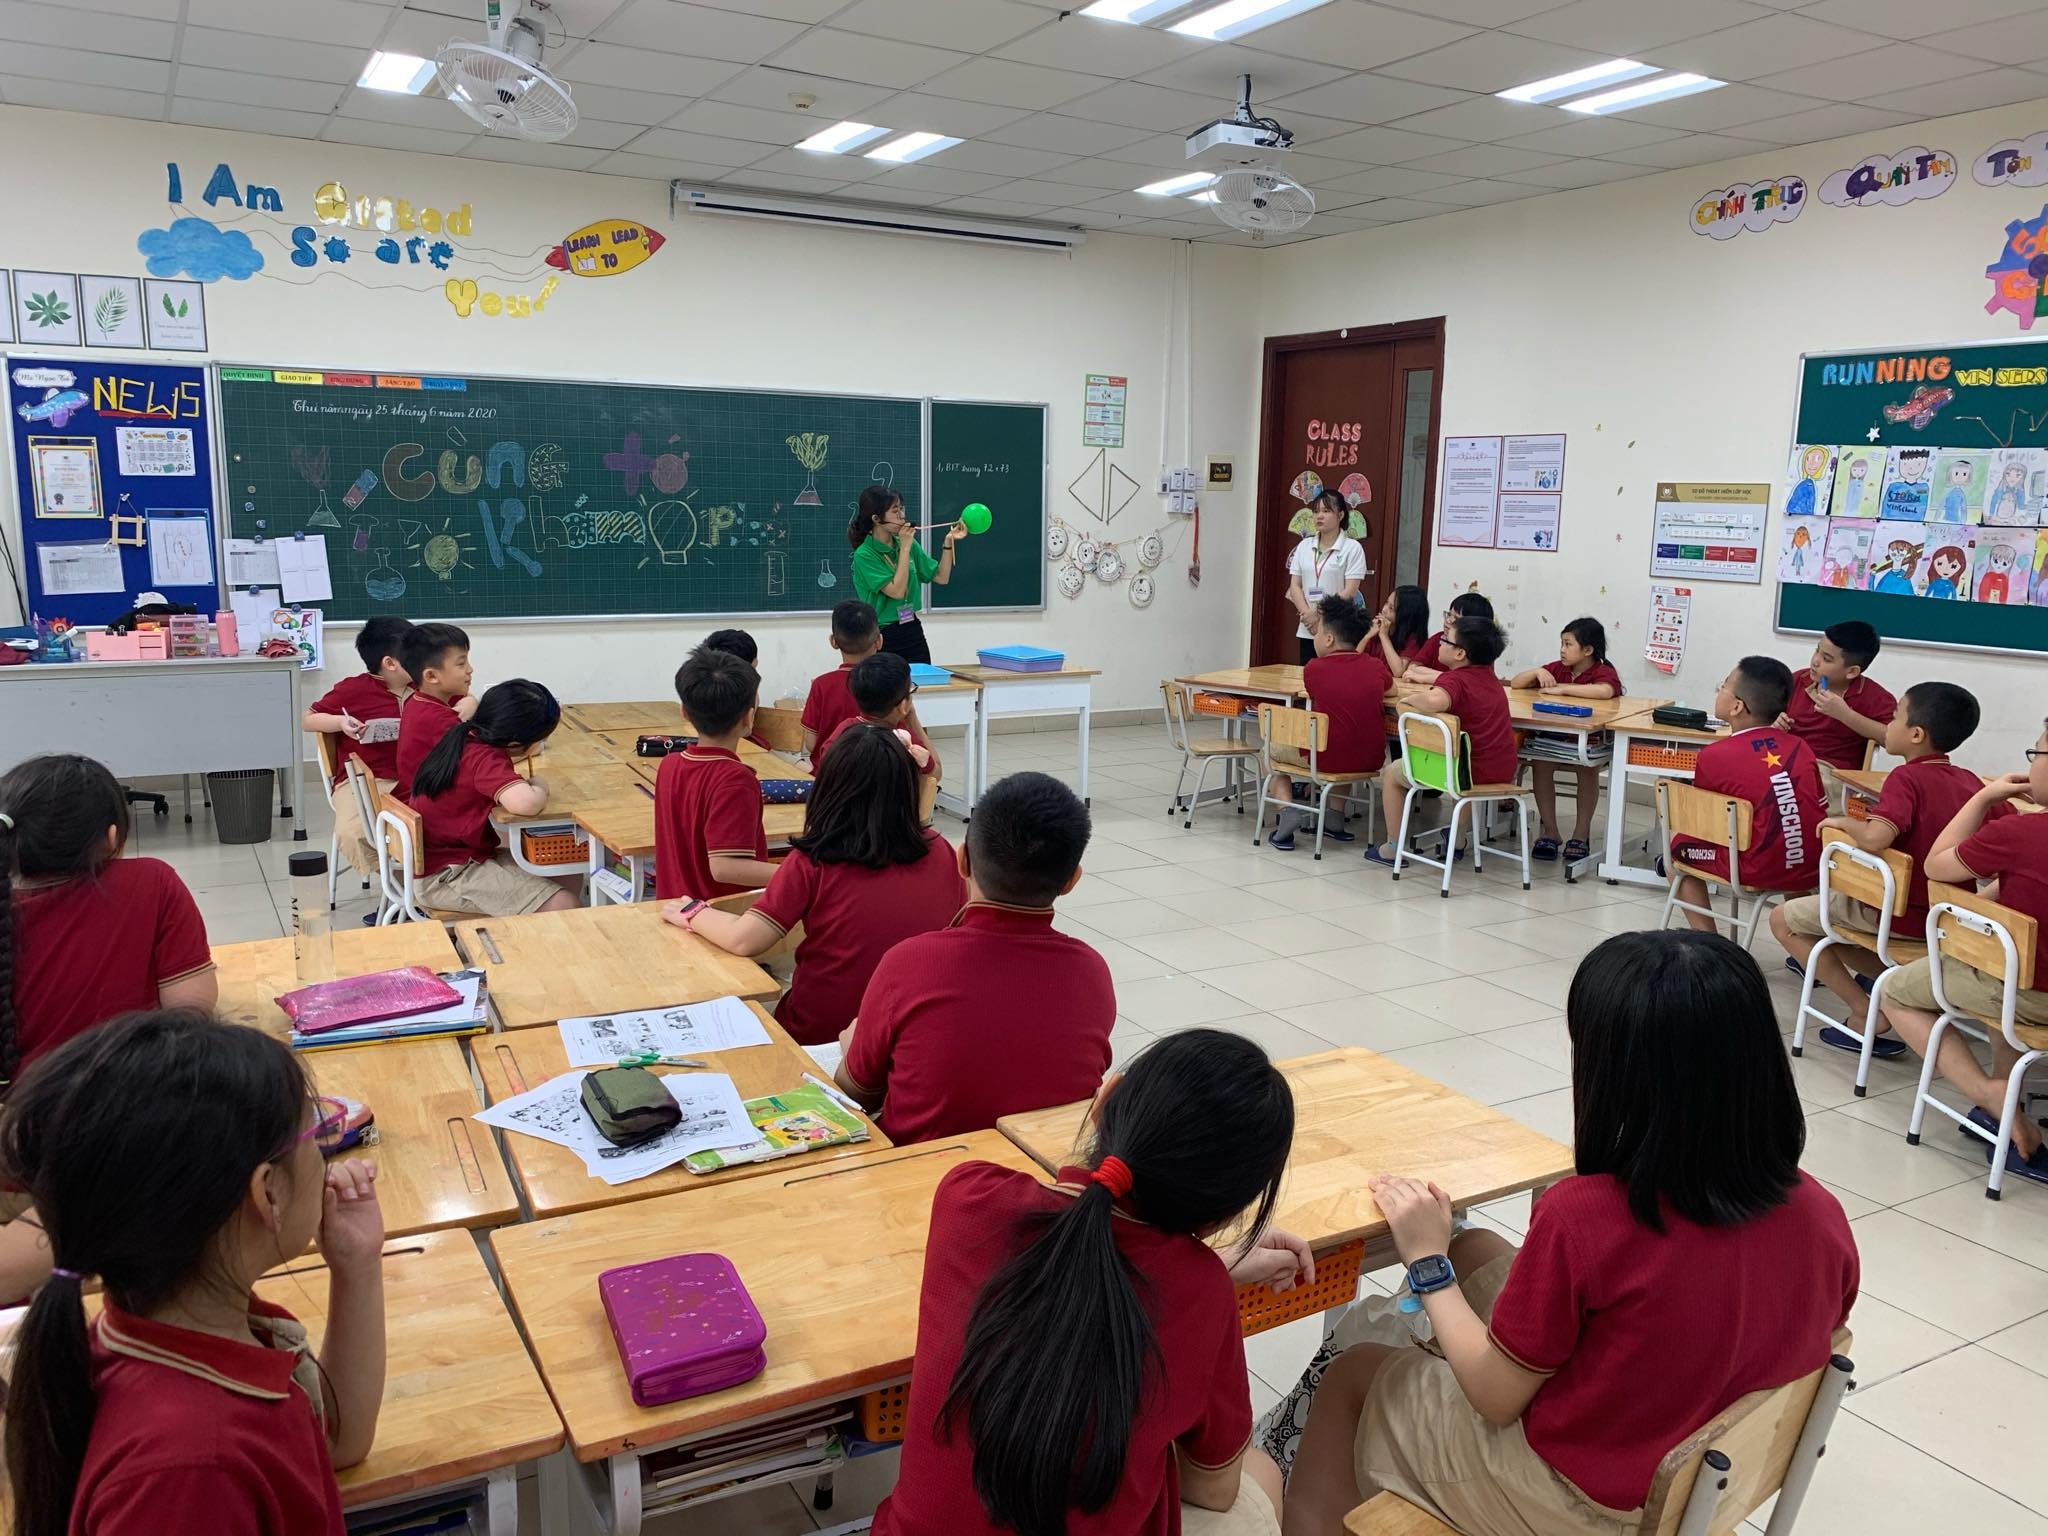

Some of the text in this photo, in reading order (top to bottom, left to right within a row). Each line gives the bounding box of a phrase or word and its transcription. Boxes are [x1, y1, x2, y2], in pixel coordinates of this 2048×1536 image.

[167, 163, 182, 203] I
[203, 164, 283, 212] Am
[290, 226, 454, 271] So are
[567, 228, 639, 253] LEARN LEAD
[601, 253, 618, 268] TO
[1823, 357, 1950, 387] RUNNING
[1955, 368, 1993, 386] VIN
[94, 376, 200, 420] NEWS
[375, 405, 388, 415] 25
[391, 403, 428, 423] tháng
[430, 407, 437, 417] 6
[439, 408, 466, 418] năm
[468, 408, 497, 419] 2020
[1307, 419, 1362, 442] CLASS
[1306, 442, 1358, 467] RULES
[1751, 737, 1777, 752] PE
[1770, 770, 1804, 869] VINSCHOOL
